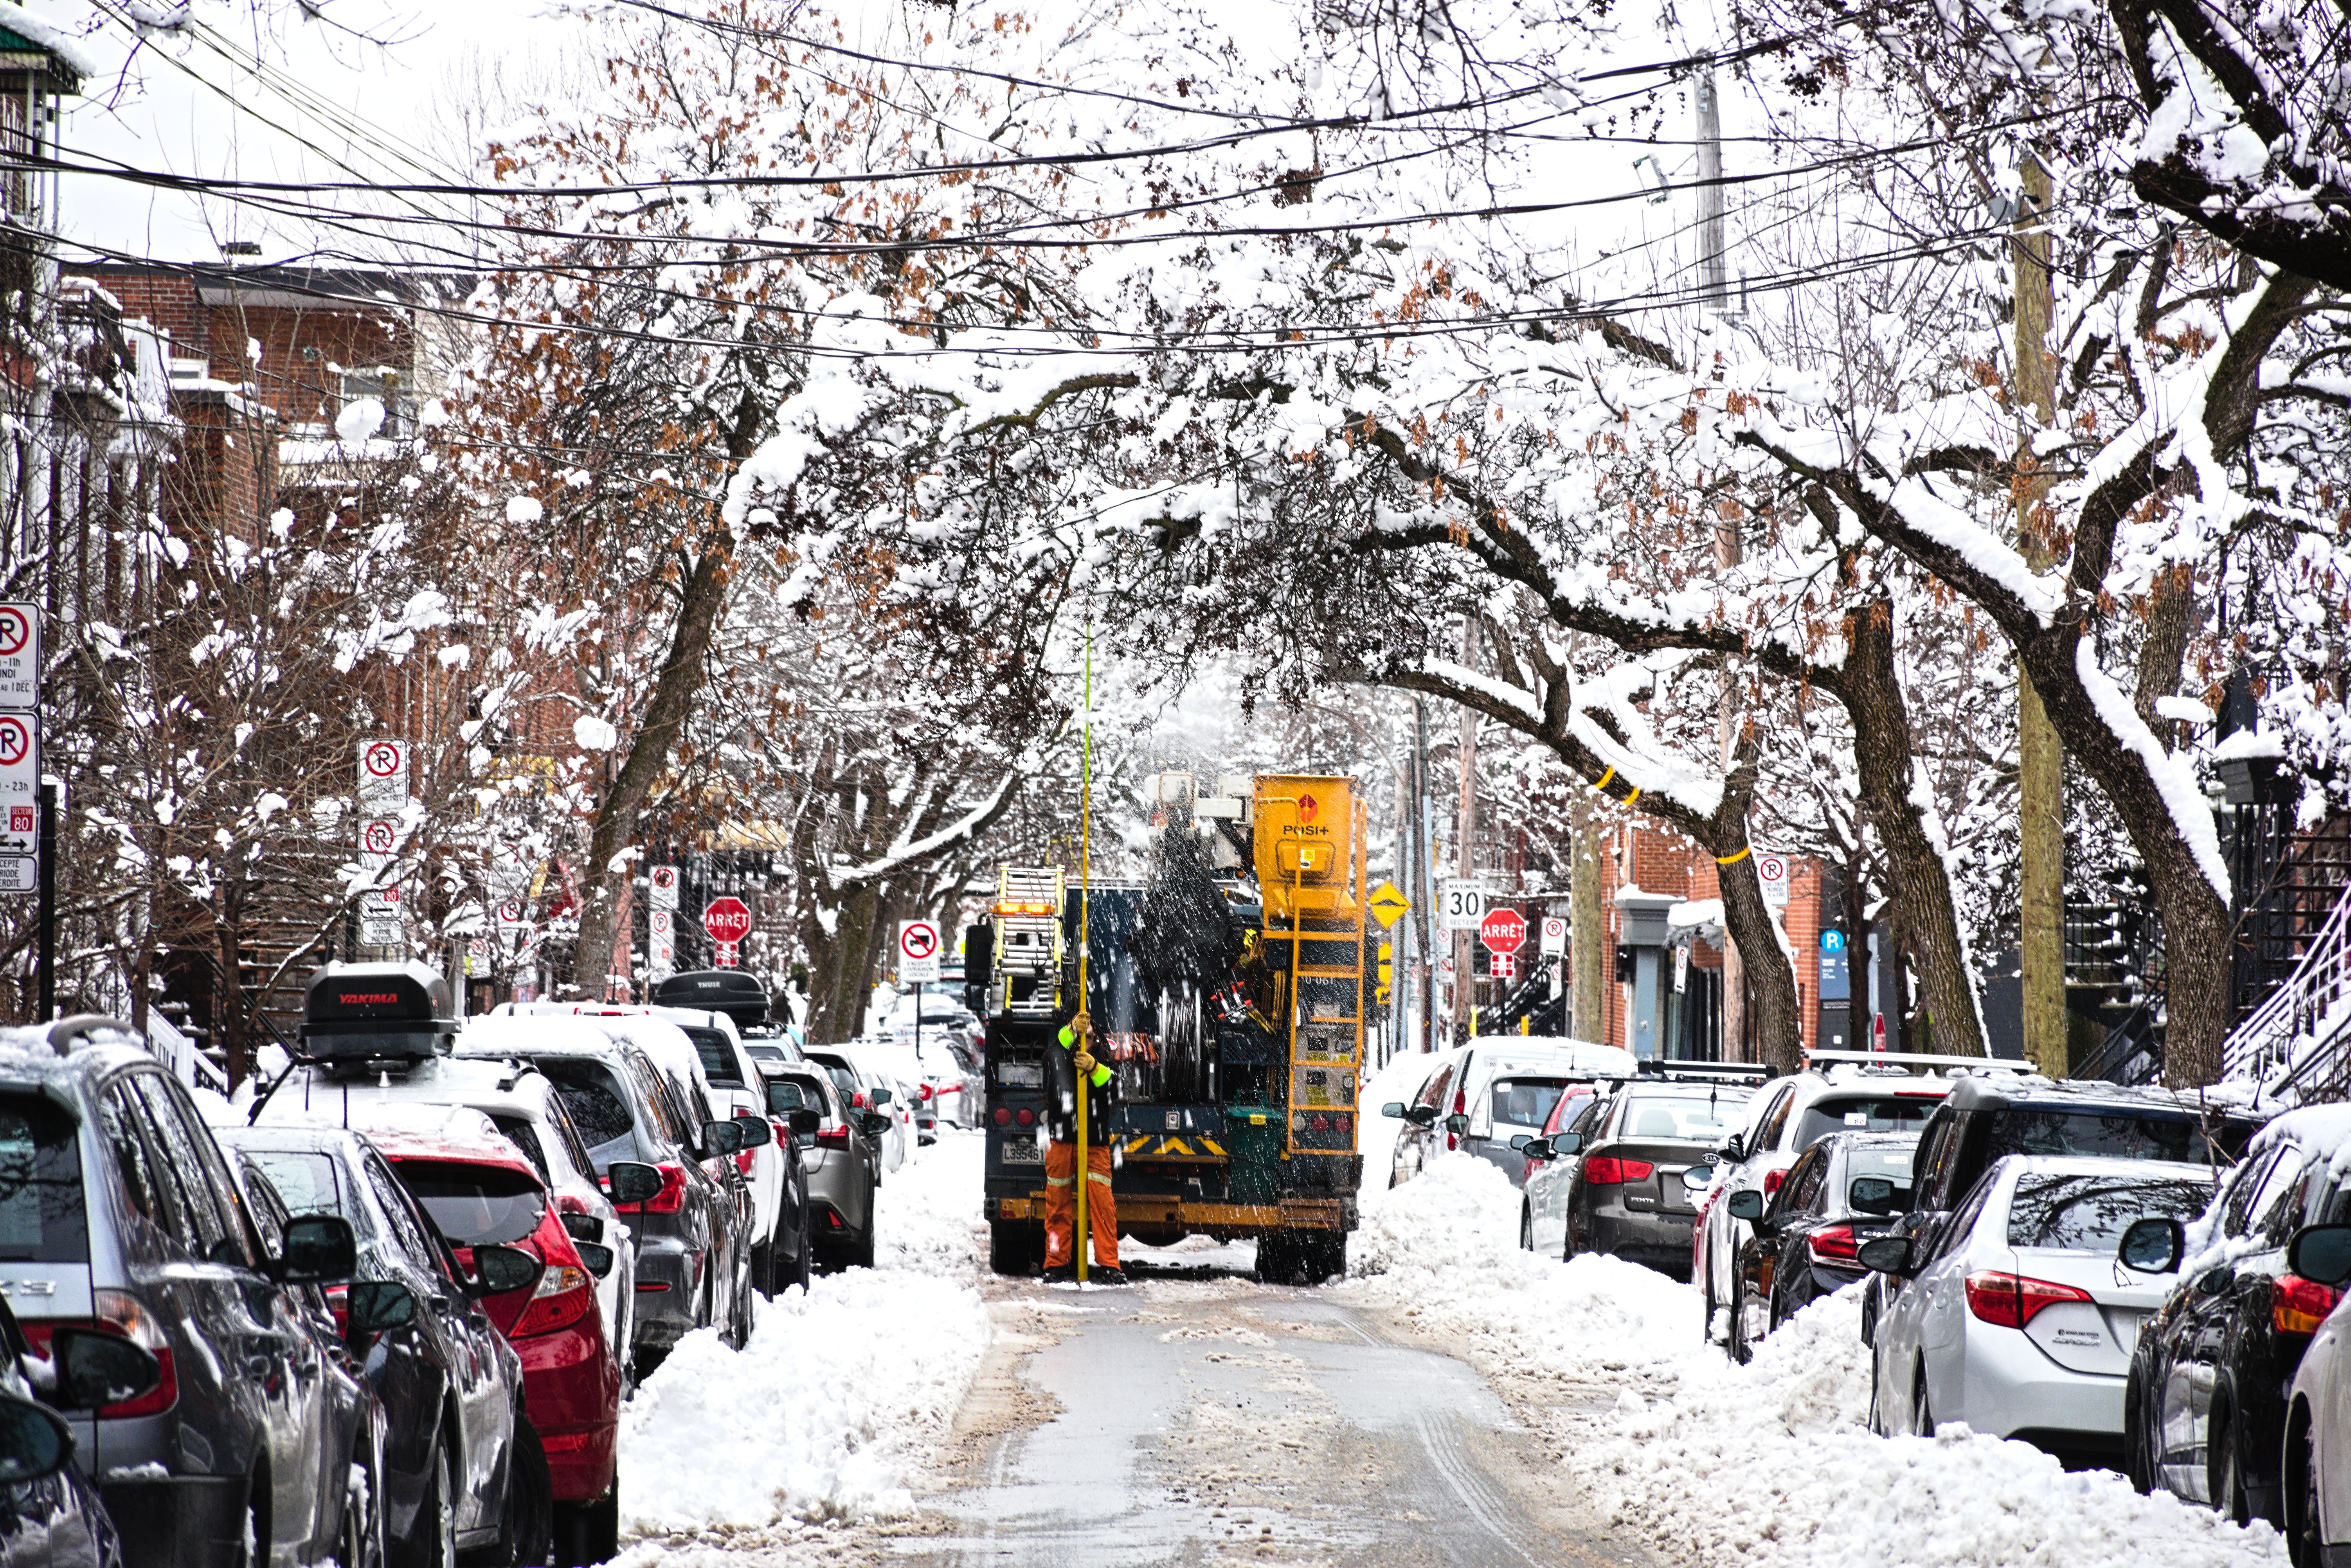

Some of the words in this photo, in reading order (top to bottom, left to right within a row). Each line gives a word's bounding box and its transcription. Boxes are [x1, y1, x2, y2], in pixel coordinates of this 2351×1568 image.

[13, 782, 28, 791] 23h
[14, 816, 29, 830] 80
[1449, 892, 1479, 916] 30
[707, 912, 748, 928] ARRÊT
[1483, 922, 1523, 938] ARRÊT
[339, 993, 398, 1004] YAKIMA
